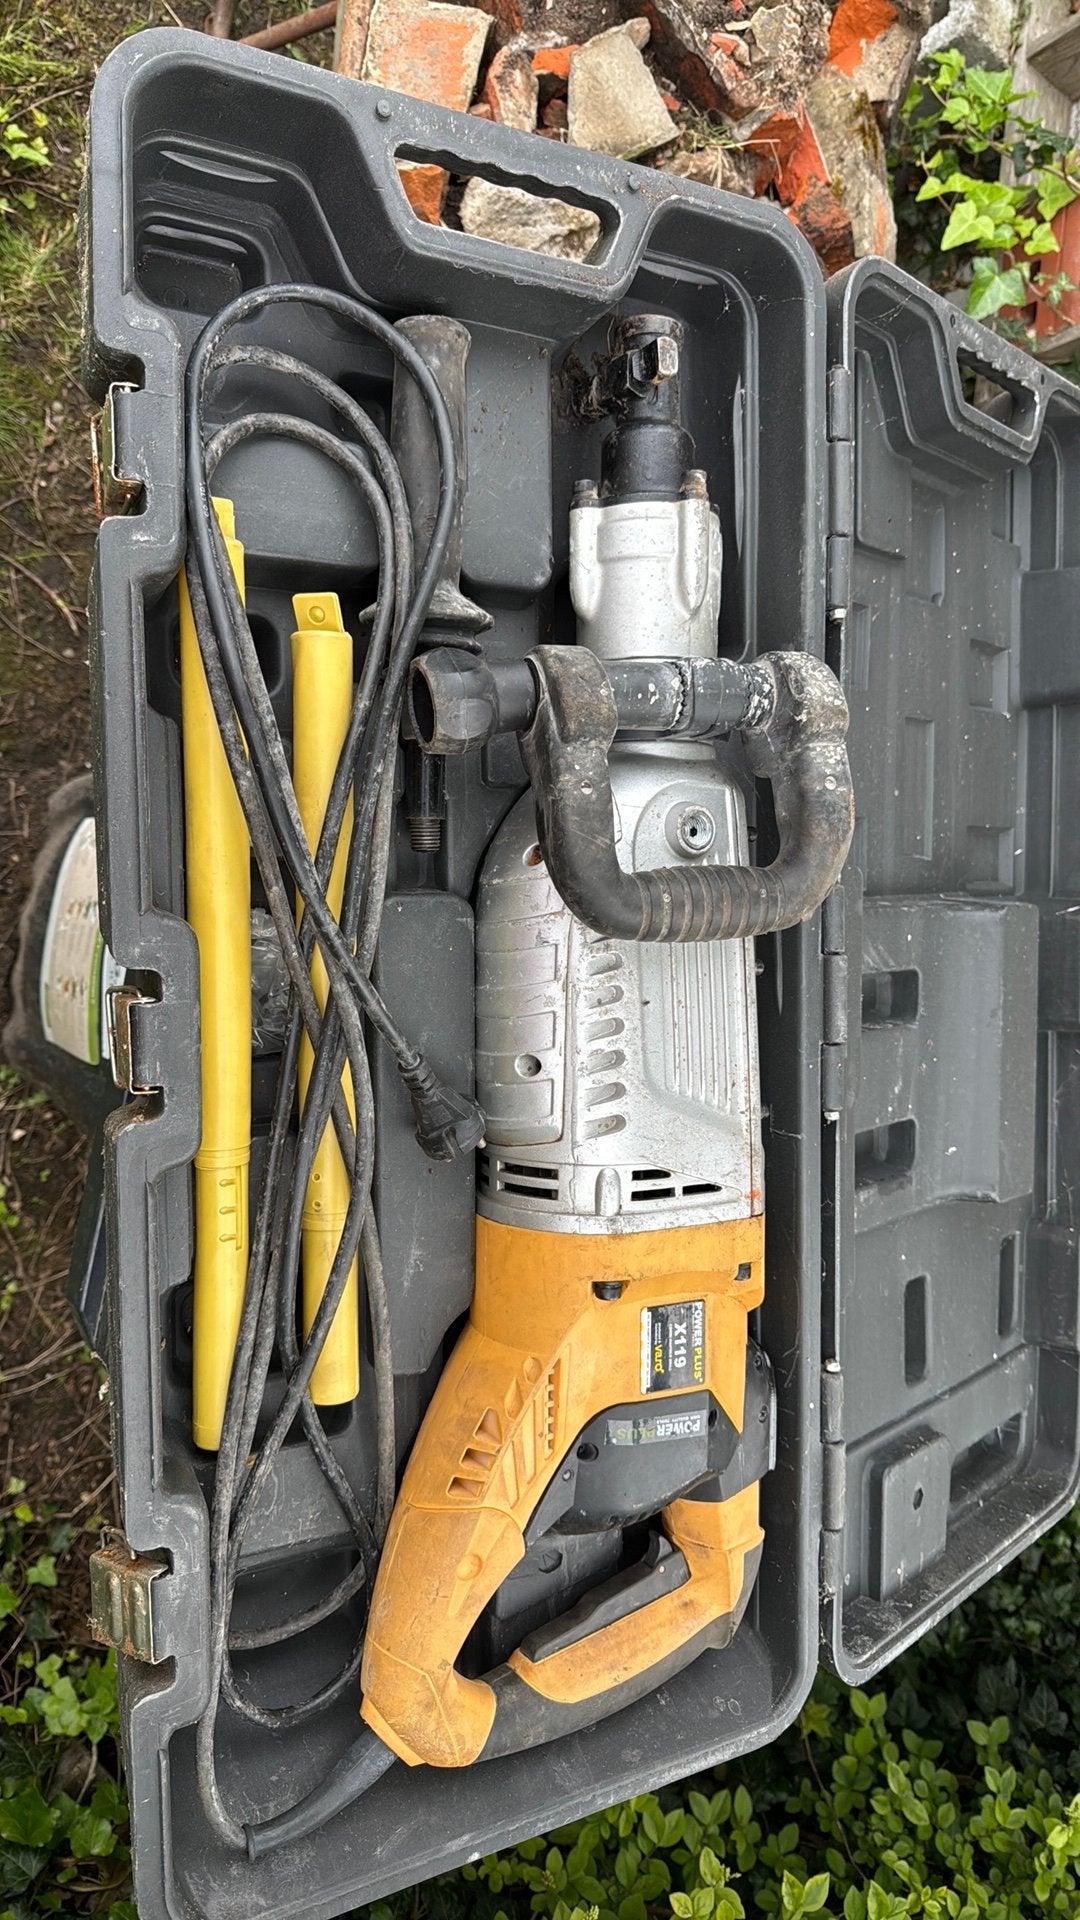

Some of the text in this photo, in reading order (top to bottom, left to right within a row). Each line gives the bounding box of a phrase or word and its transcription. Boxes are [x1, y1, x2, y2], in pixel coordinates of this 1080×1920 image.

[654, 1344, 663, 1373] varo
[674, 1321, 687, 1369] X119
[694, 1301, 703, 1379] POWER PLUS
[656, 1420, 701, 1437] POWER
